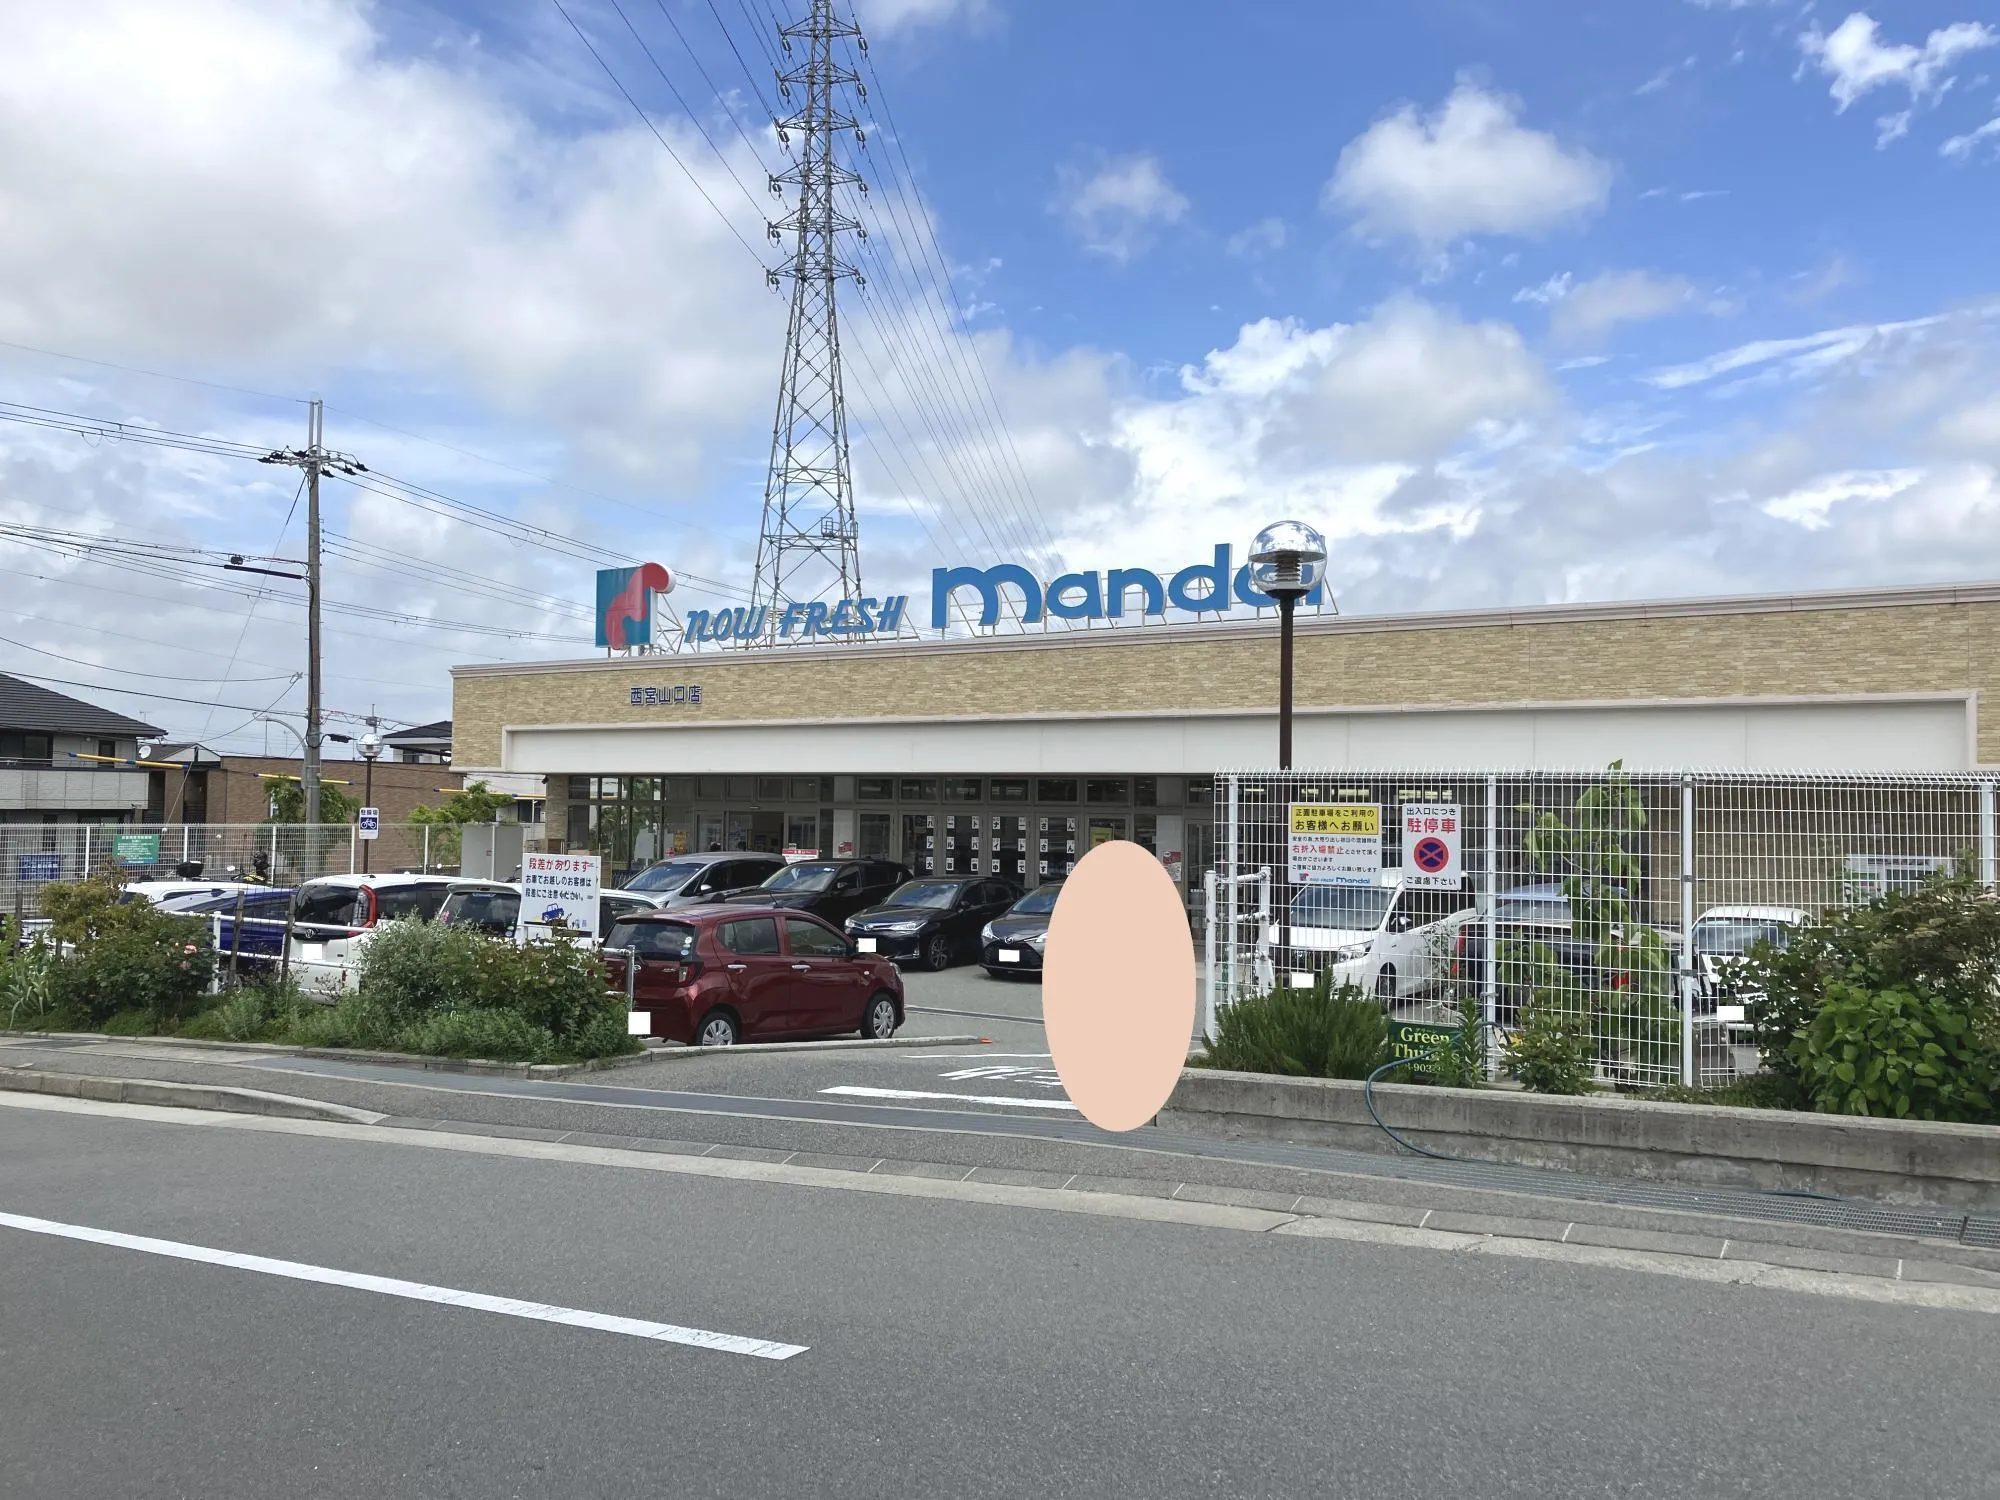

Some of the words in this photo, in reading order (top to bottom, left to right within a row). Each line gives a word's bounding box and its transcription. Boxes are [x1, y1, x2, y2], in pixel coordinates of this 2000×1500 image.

[780, 596, 909, 638] FRESH
[630, 685, 702, 705] 西宮山口店
[1295, 808, 1375, 818] 正面駐車場をご利用の
[1406, 807, 1456, 815] 出入口につき
[1295, 820, 1375, 831] お客様へお願い
[1407, 818, 1456, 833] 駐停車
[529, 857, 590, 872] 段差があります
[526, 875, 592, 888] お車でお越しのお客様は
[1406, 877, 1456, 885] ご遠慮下さい
[1401, 1027, 1450, 1044] Green
